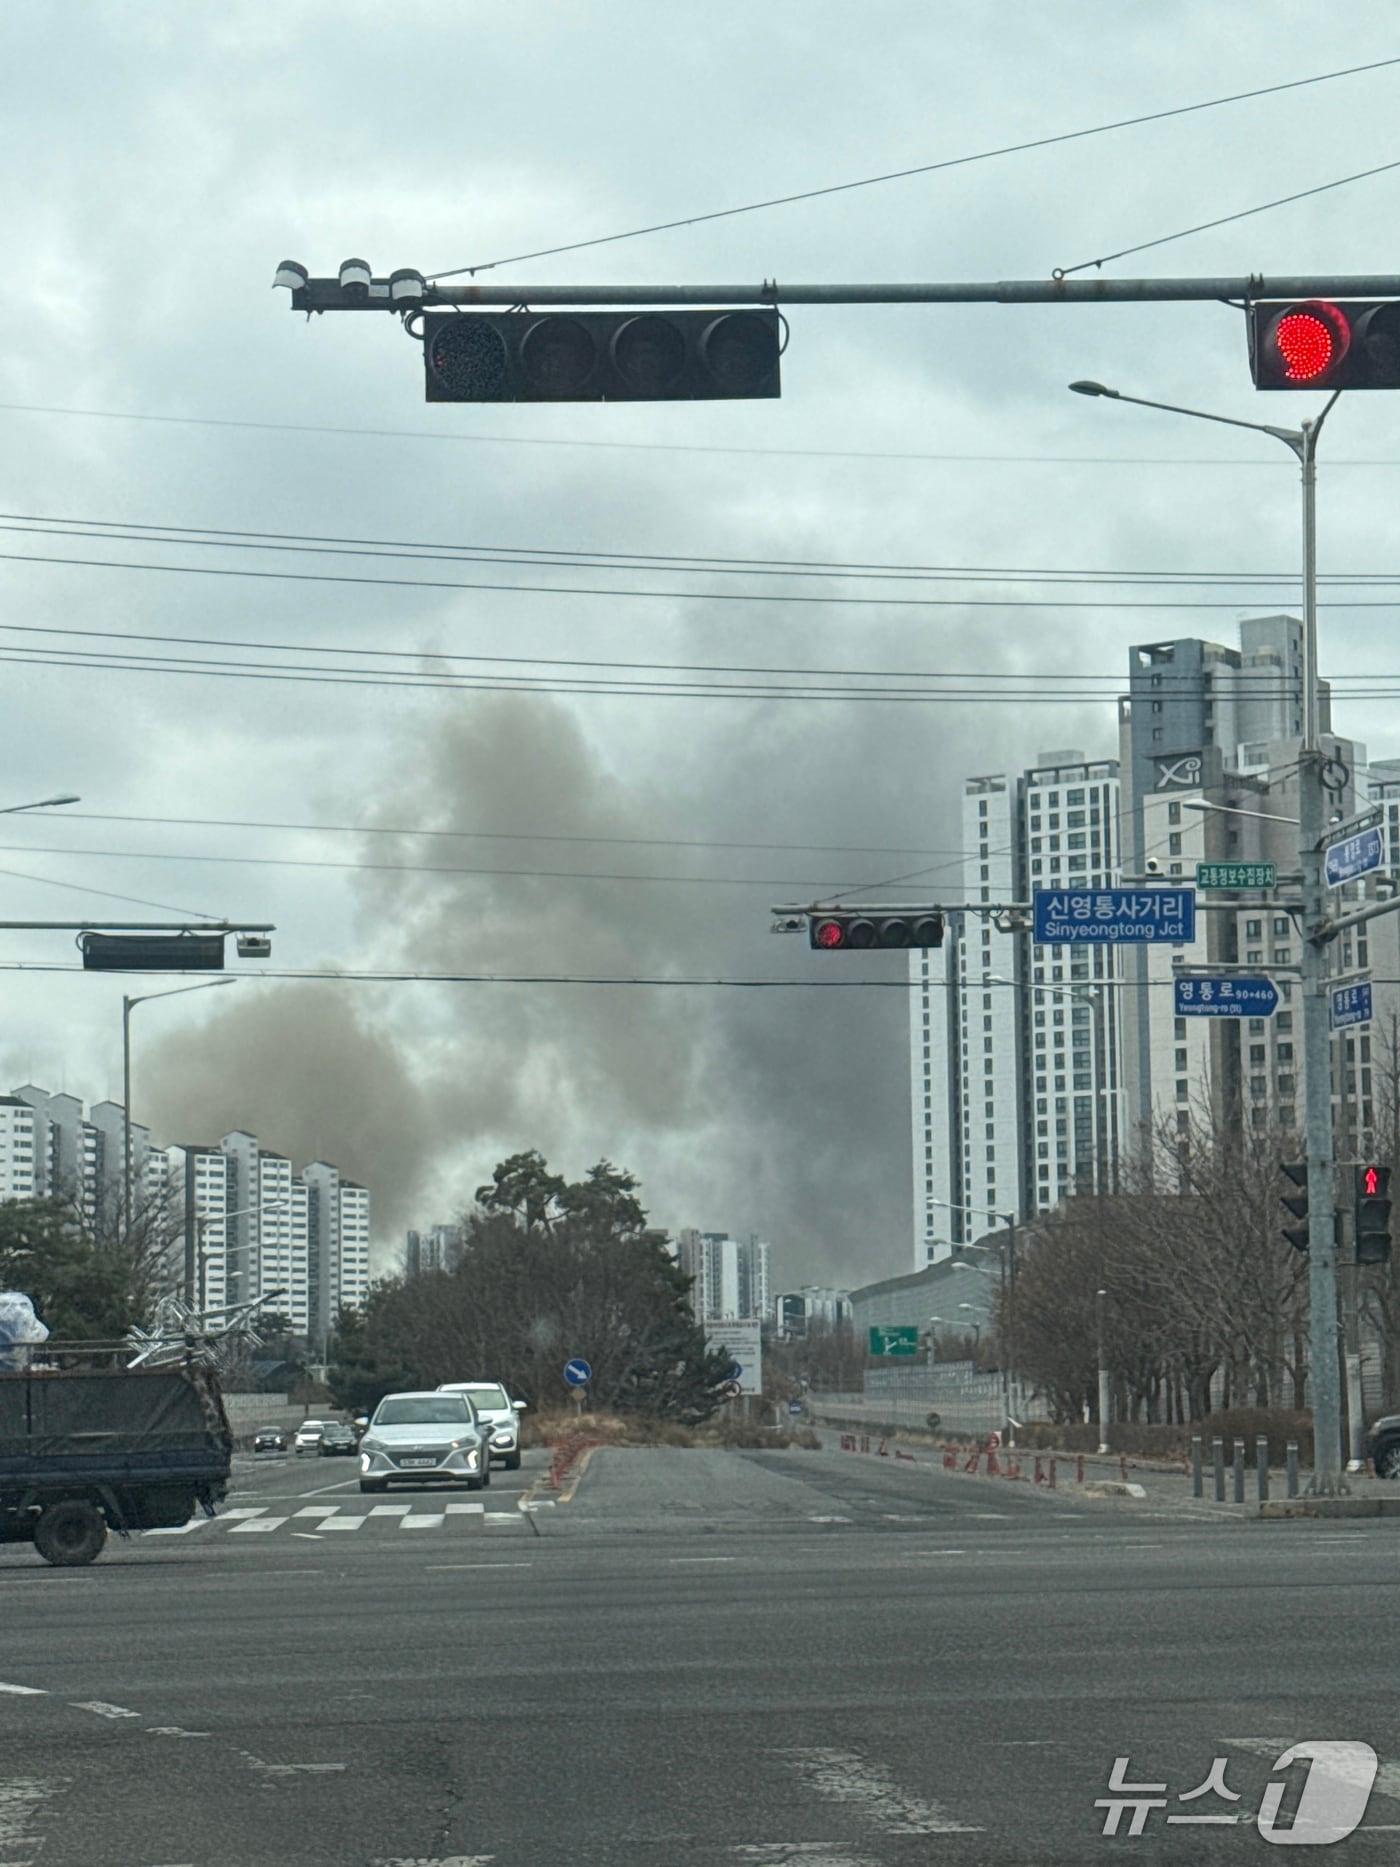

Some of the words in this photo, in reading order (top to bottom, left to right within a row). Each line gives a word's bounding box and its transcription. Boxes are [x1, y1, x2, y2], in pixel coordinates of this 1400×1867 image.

[1200, 867, 1274, 886] 교통정보수집장치
[1046, 895, 1184, 920] 신영통사거리
[1045, 922, 1155, 939] Sinyeongtong
[1159, 921, 1184, 937] Jct
[1179, 981, 1235, 1001] 영통로
